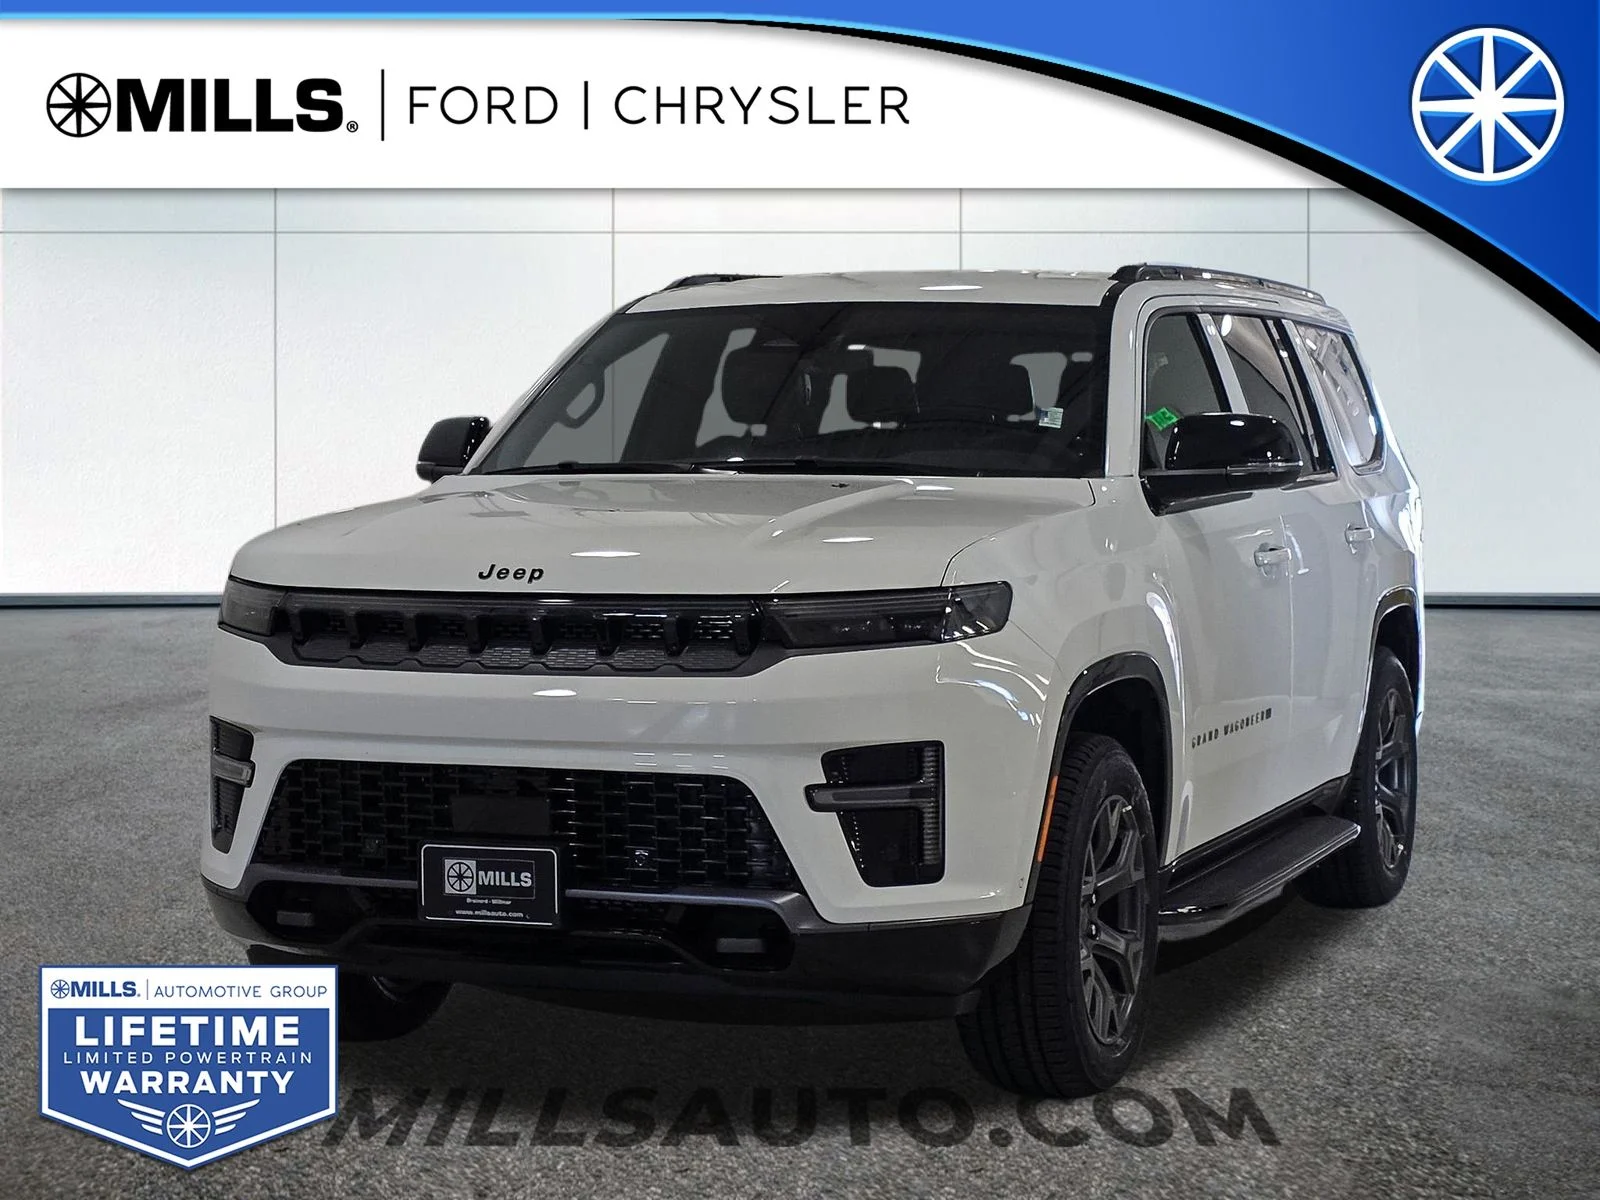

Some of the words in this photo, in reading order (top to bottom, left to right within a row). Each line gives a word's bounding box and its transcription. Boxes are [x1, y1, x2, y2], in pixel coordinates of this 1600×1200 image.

[478, 563, 544, 584] Jeep
[1191, 728, 1219, 749] GRAND
[478, 870, 532, 887] MILLS
[455, 909, 523, 918] www.millsauto.com
